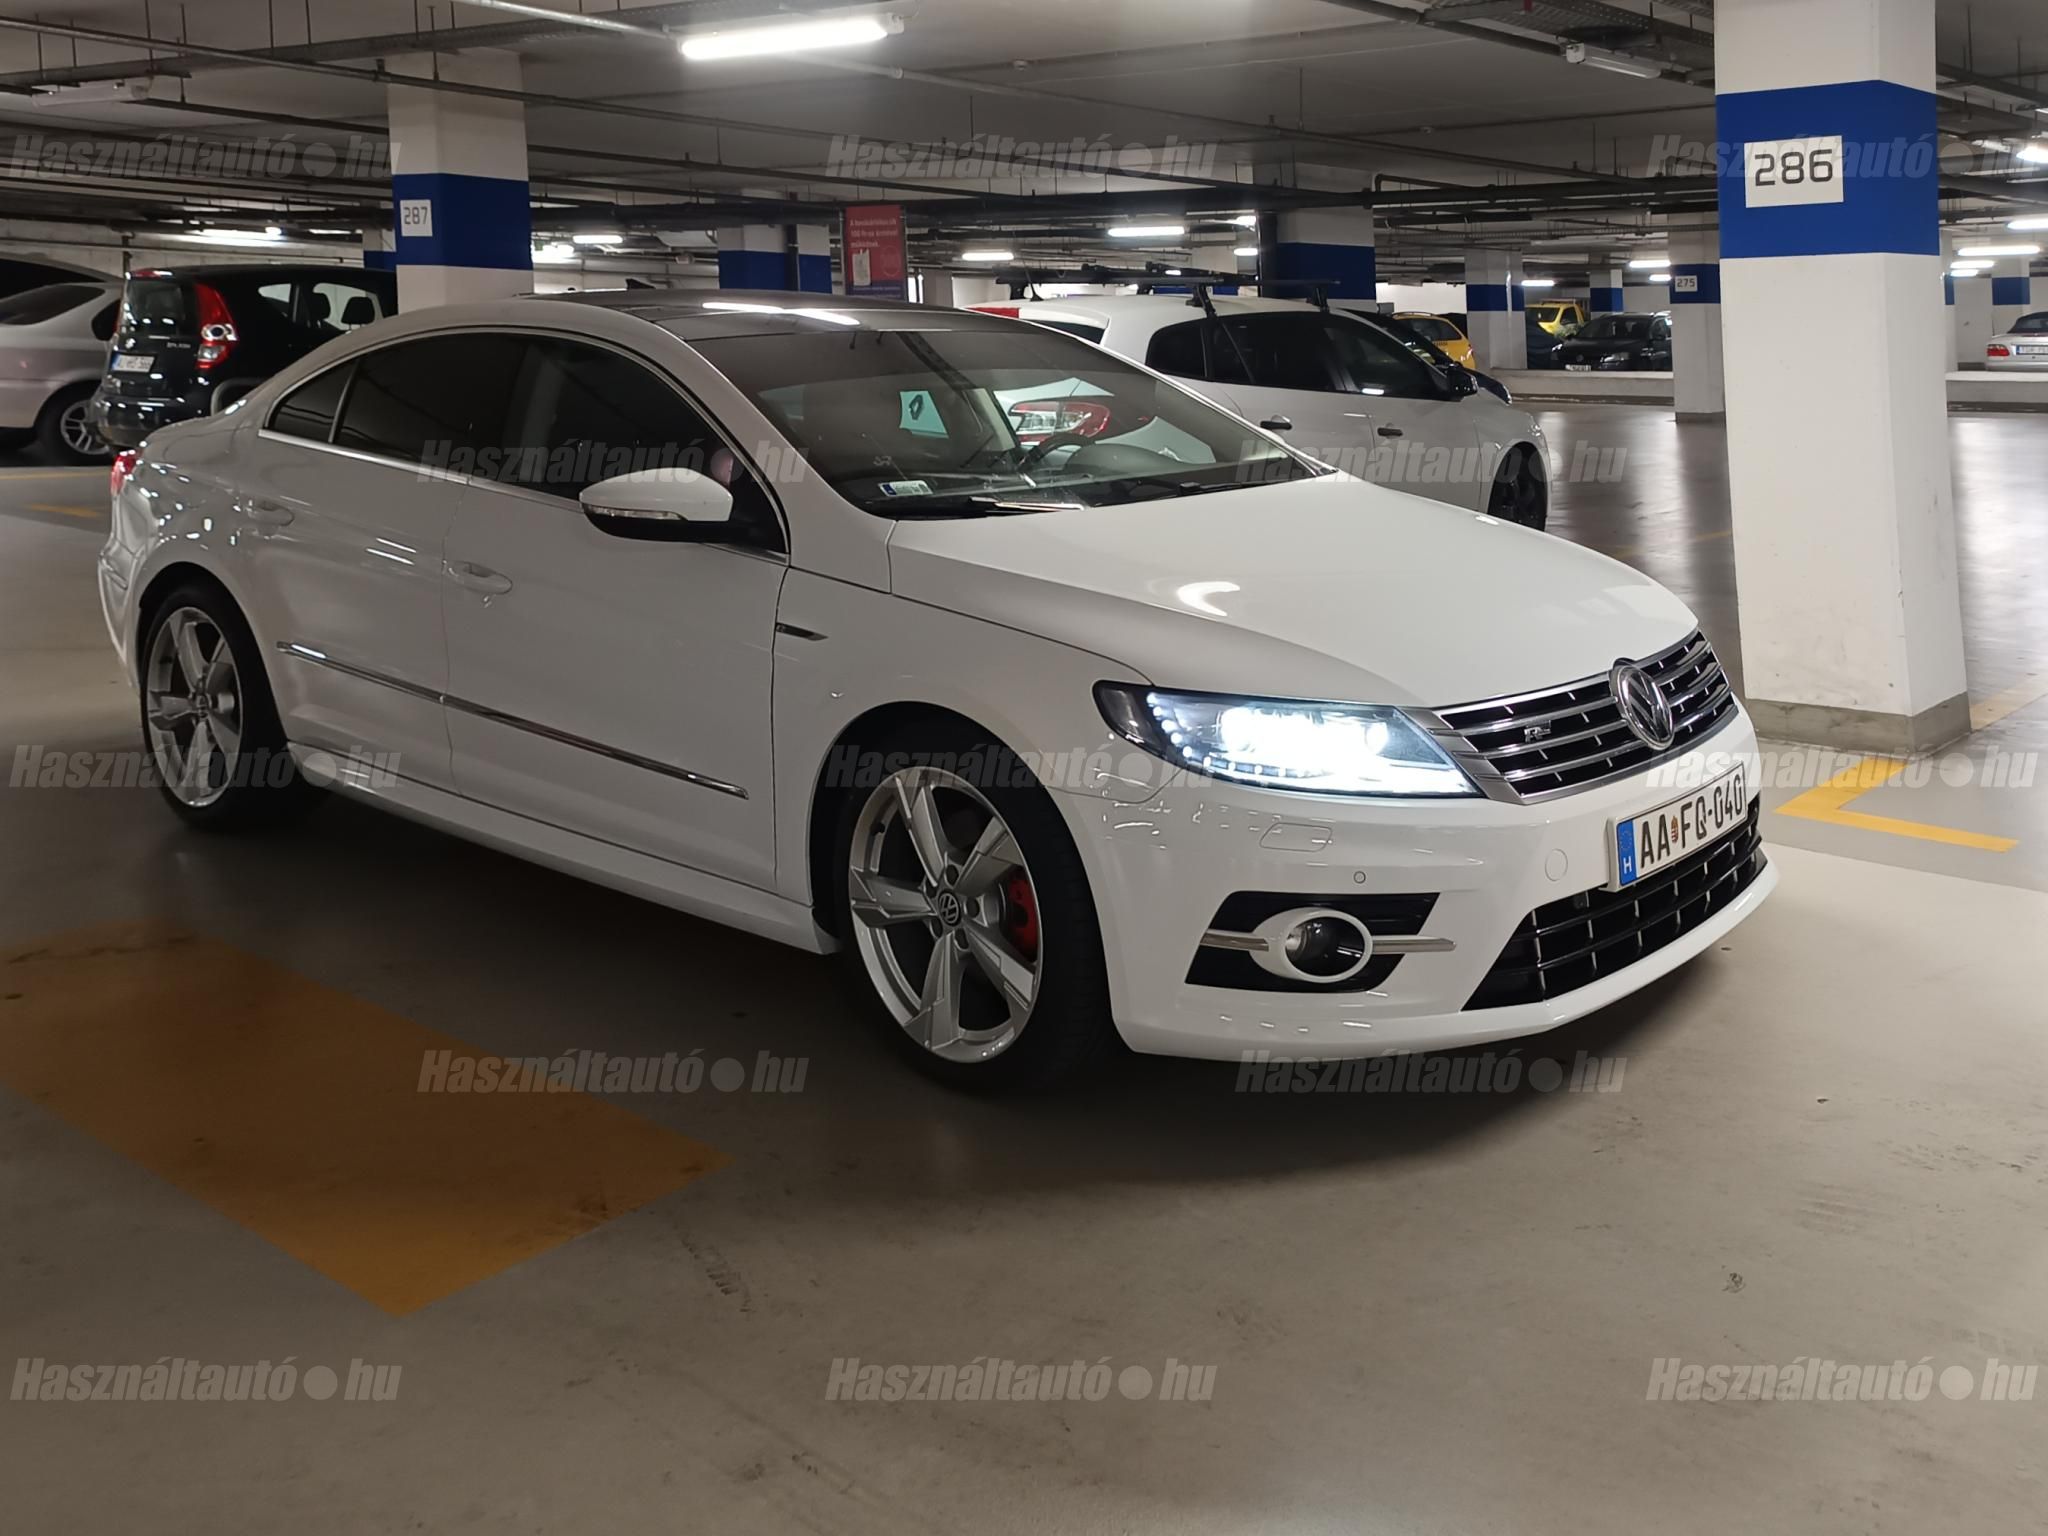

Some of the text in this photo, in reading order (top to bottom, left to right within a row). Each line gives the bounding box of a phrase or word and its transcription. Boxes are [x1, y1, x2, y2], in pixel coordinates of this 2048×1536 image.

[1754, 148, 1833, 187] 286
[403, 206, 428, 225] 287
[1677, 278, 1696, 288] 275
